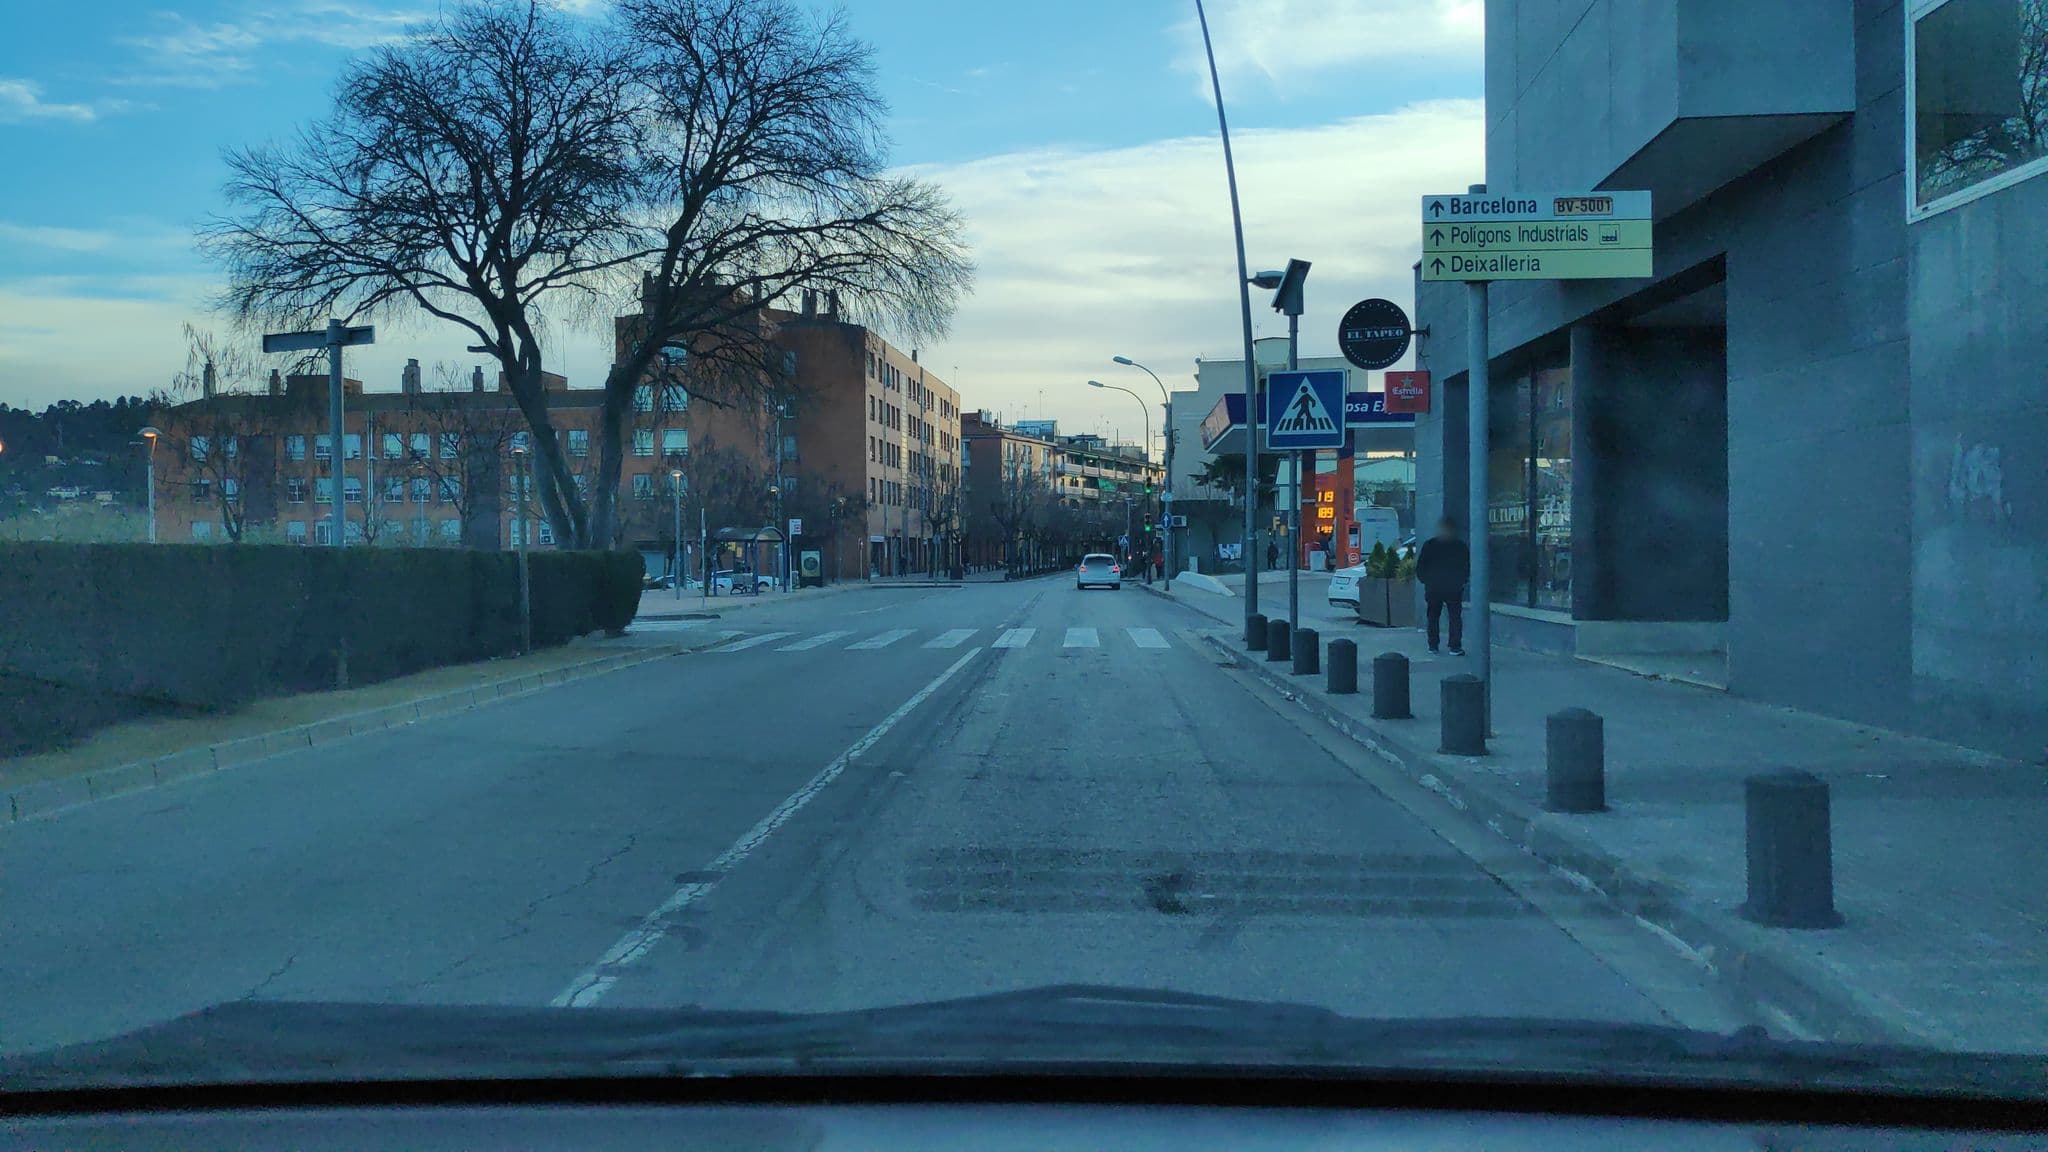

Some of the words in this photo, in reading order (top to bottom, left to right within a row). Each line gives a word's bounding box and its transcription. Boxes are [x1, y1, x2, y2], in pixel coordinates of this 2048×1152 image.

[1451, 197, 1537, 215] Barcelona
[1557, 200, 1612, 213] BV-5001
[1451, 225, 1511, 248] Polígons
[1451, 255, 1541, 273] Deixalleria
[1347, 331, 1362, 339] EL
[1366, 329, 1404, 338] TAPEO
